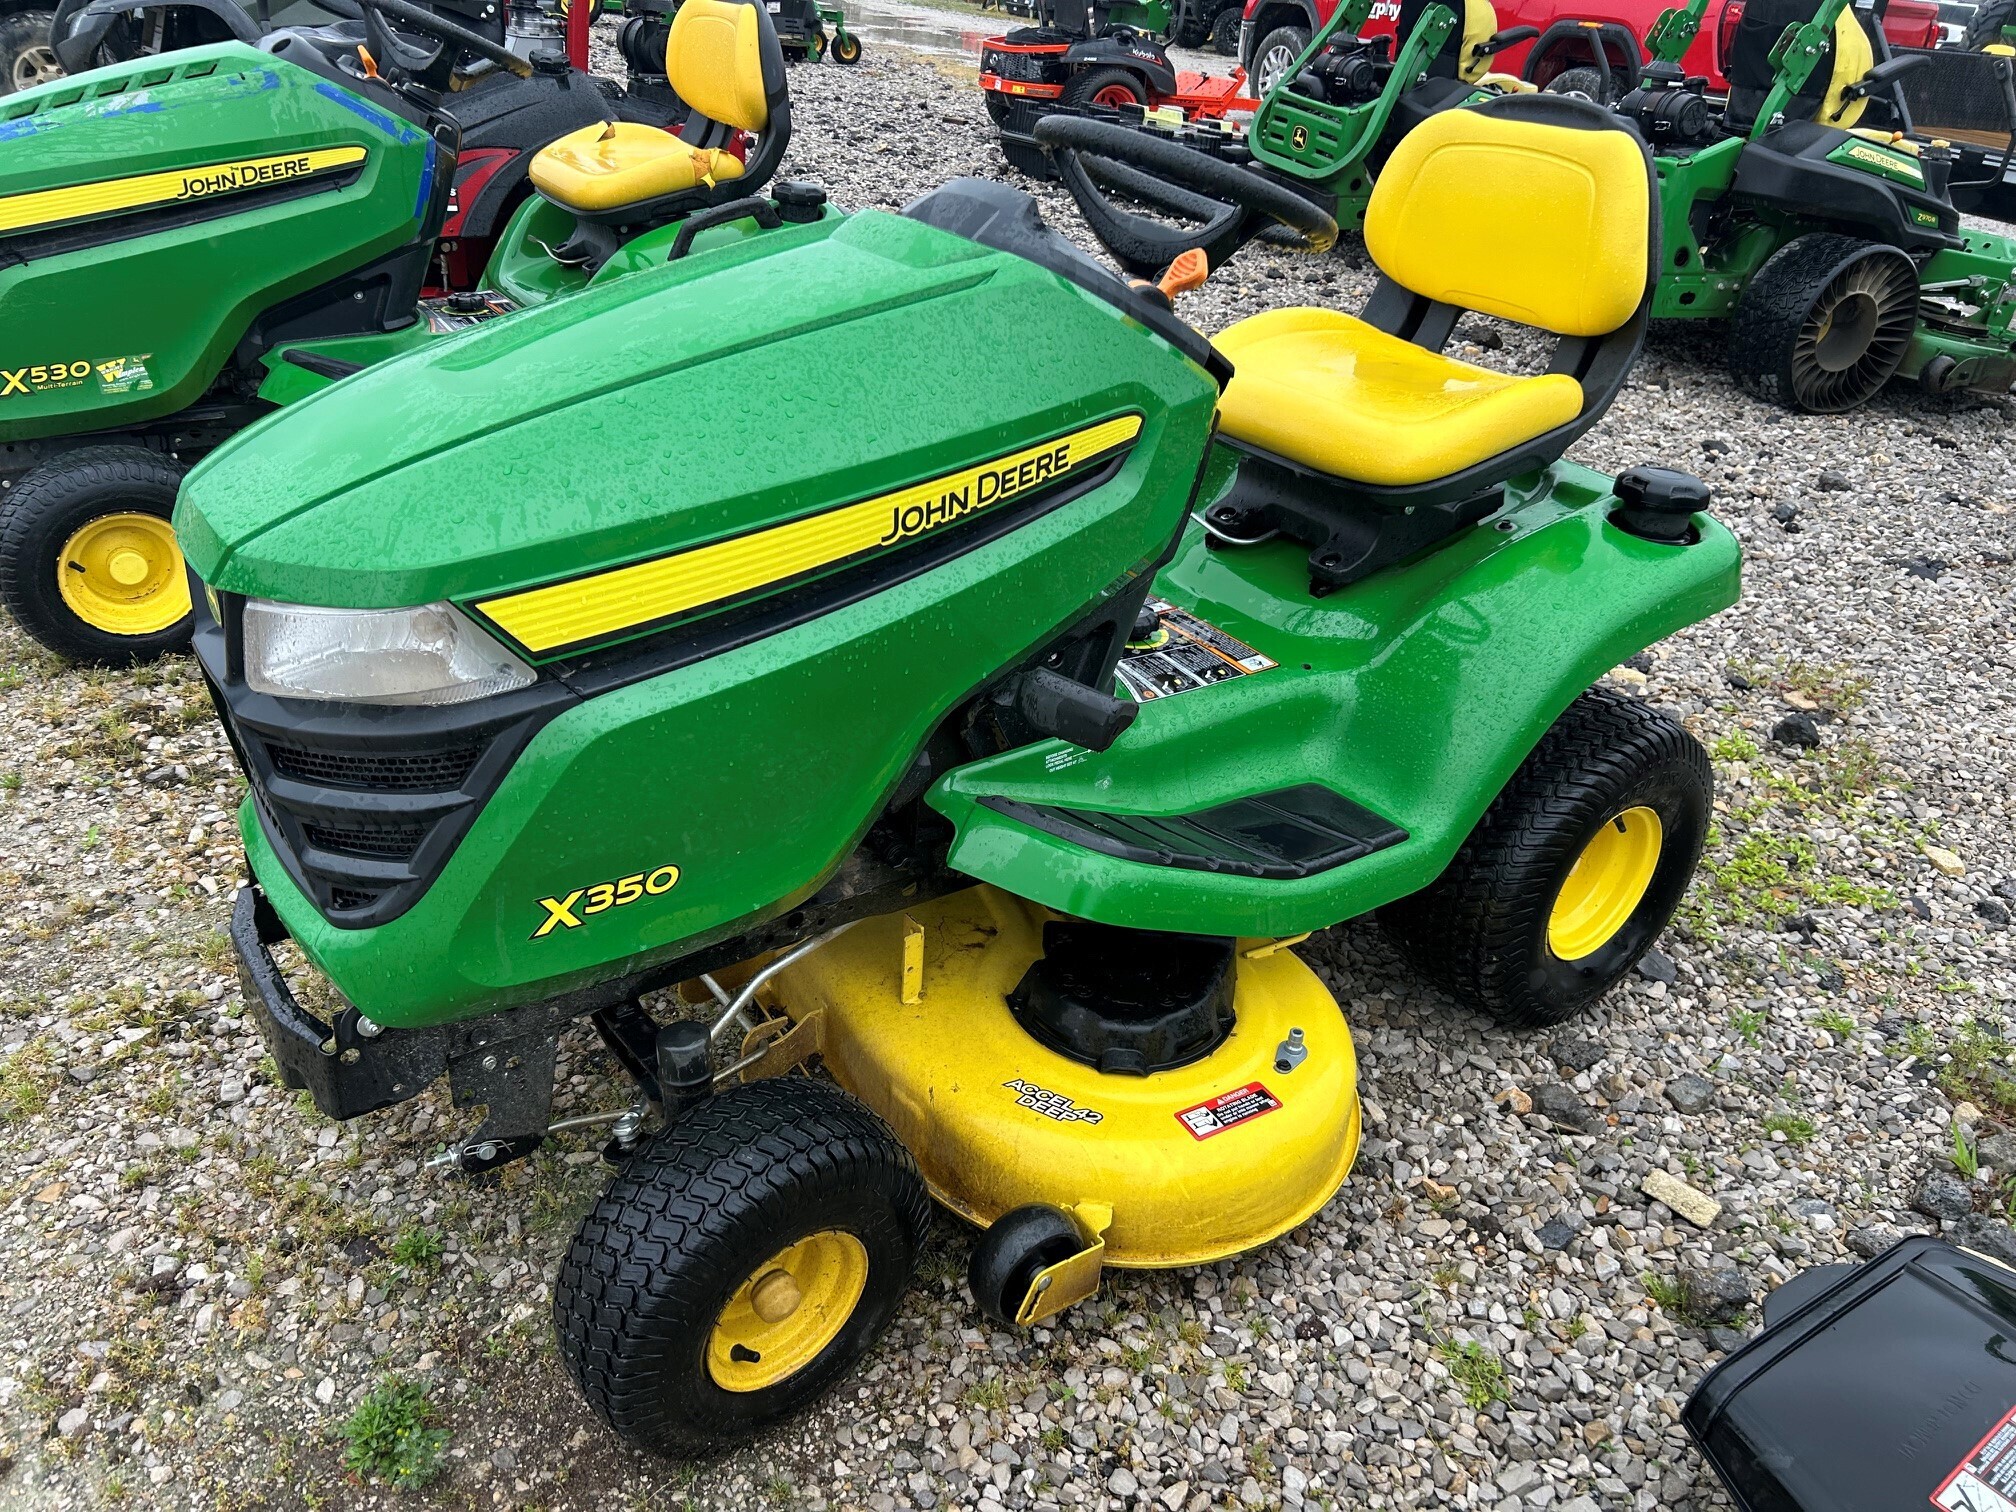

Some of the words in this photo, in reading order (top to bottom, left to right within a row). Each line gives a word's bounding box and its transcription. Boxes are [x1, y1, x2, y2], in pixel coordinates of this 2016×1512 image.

[1856, 148, 1875, 161] JOHN
[1876, 154, 1899, 169] DEERE
[177, 172, 237, 198] JOHN
[240, 157, 312, 184] DEERE
[0, 360, 92, 397] X530
[36, 380, 83, 391] Multi-Terrain
[881, 486, 969, 543] JOHN
[976, 443, 1071, 507] DEERE
[528, 863, 682, 940] X350
[1002, 1078, 1075, 1112] ACCEL
[1073, 1108, 1104, 1125] 42
[1015, 1094, 1078, 1121] DEEP
[1216, 1100, 1241, 1112] ROTATING
[1241, 1093, 1258, 1102] BLADE
[1222, 1088, 1249, 1102] DANGER
